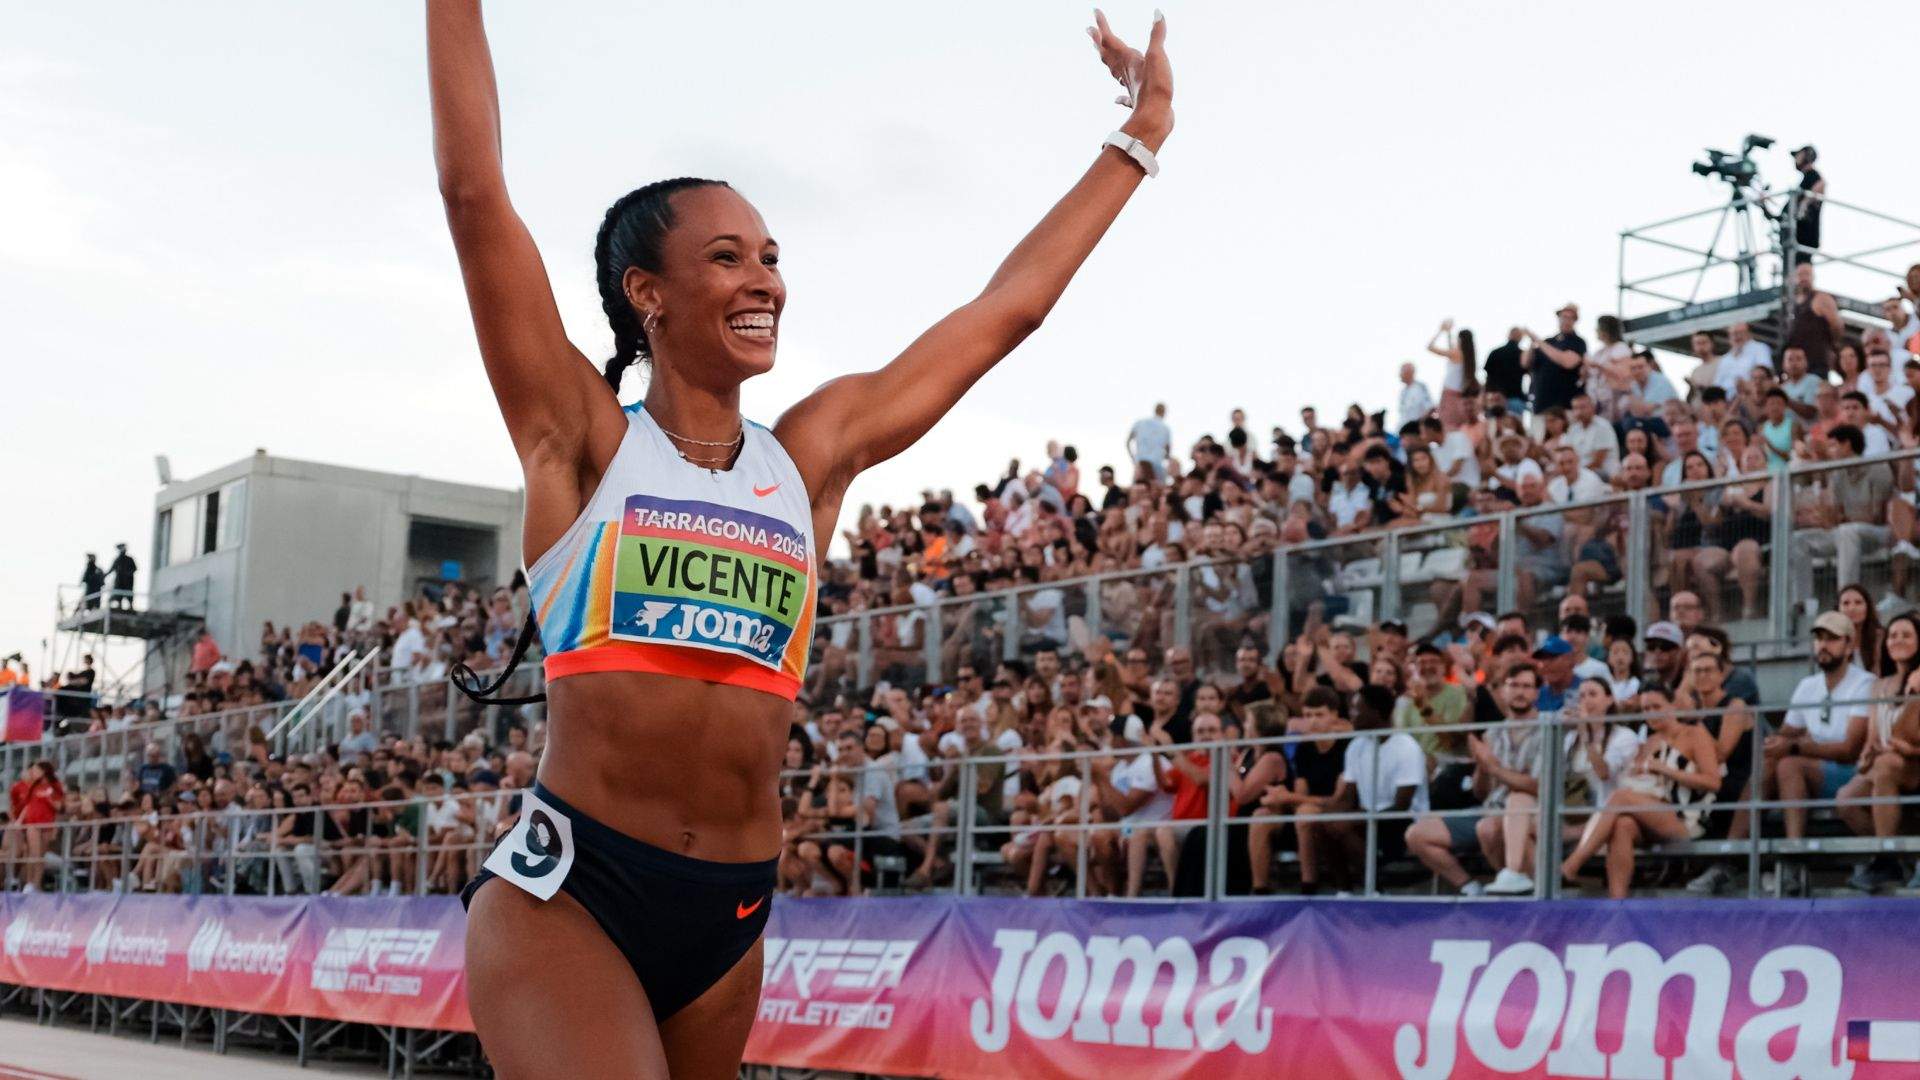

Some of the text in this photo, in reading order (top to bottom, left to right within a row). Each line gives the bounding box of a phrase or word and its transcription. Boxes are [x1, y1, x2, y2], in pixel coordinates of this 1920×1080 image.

[634, 507, 806, 562] TARRAGONA 2025
[639, 543, 796, 616] VICENTE
[510, 809, 563, 878] 9
[769, 939, 919, 999] RFEA
[757, 999, 896, 1029] ATLETISMO
